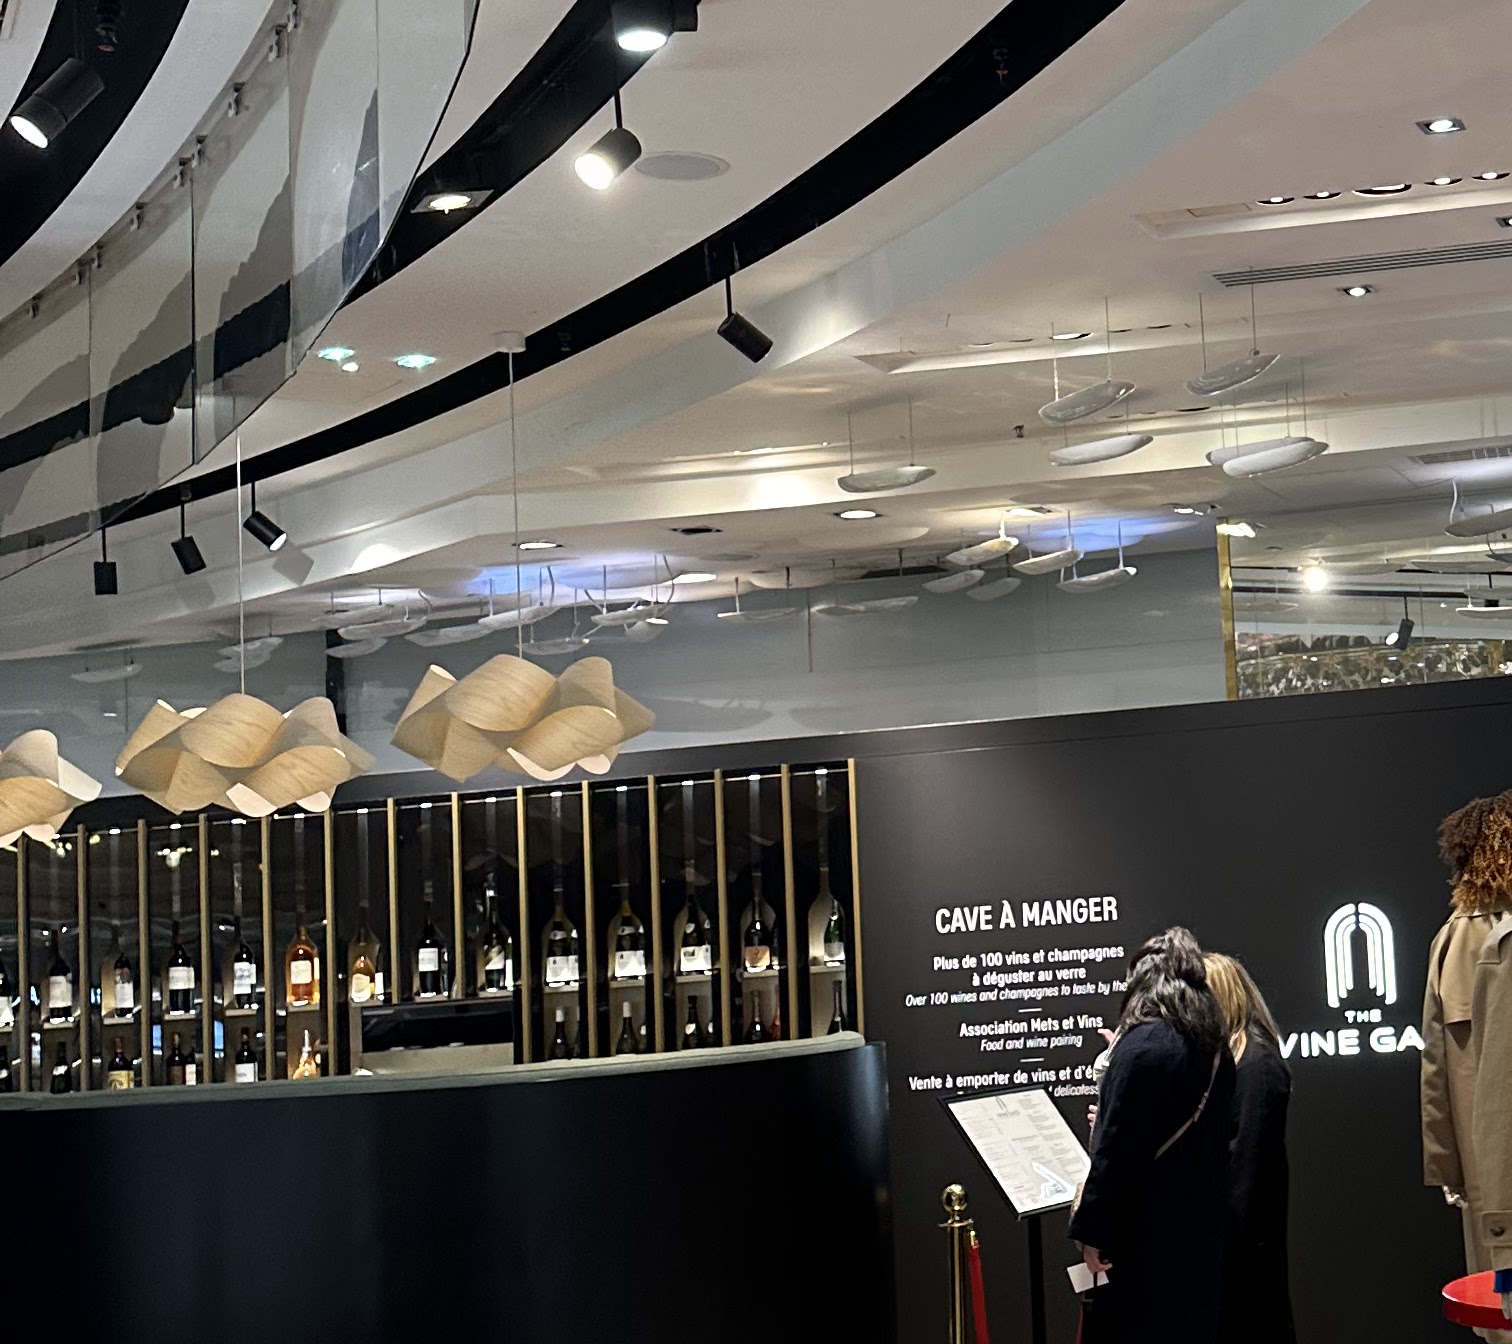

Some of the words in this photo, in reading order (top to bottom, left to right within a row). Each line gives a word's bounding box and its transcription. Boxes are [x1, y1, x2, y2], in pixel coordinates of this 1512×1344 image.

[935, 905, 993, 934] CAVE
[999, 899, 1016, 929] À
[1022, 896, 1118, 928] MANGER
[933, 956, 959, 970] Plus
[962, 954, 977, 968] de
[980, 952, 1003, 967] 100
[1005, 951, 1030, 965] vins
[1032, 949, 1045, 963] et
[1047, 945, 1124, 963] champagnes
[972, 972, 980, 986] à
[982, 970, 1035, 988] déguster
[1037, 971, 1053, 981] au
[1055, 967, 1086, 980] verre
[905, 993, 927, 1007] Over
[930, 992, 948, 1005] 100
[950, 991, 977, 1004] wines
[979, 988, 997, 1001] and
[999, 985, 1059, 1002] champagnes
[1061, 984, 1070, 995] to
[1073, 981, 1096, 994] taste
[1097, 981, 1110, 995] by
[1112, 979, 1128, 992] the
[959, 1018, 1028, 1037] Association
[1030, 1017, 1060, 1033] Mets
[1062, 1016, 1074, 1030] et
[1076, 1014, 1103, 1029] Vins
[1344, 1008, 1382, 1023] THE
[980, 1038, 1004, 1051] Food
[1006, 1036, 1024, 1049] and
[1026, 1035, 1048, 1048] wine
[1050, 1033, 1083, 1049] pairing
[1369, 1025, 1425, 1053] GA
[908, 1075, 943, 1090] Vente
[945, 1074, 954, 1088] à
[956, 1072, 1010, 1090] emporter
[1013, 1069, 1028, 1084] de
[1030, 1067, 1056, 1082] vins
[1058, 1066, 1072, 1080] et
